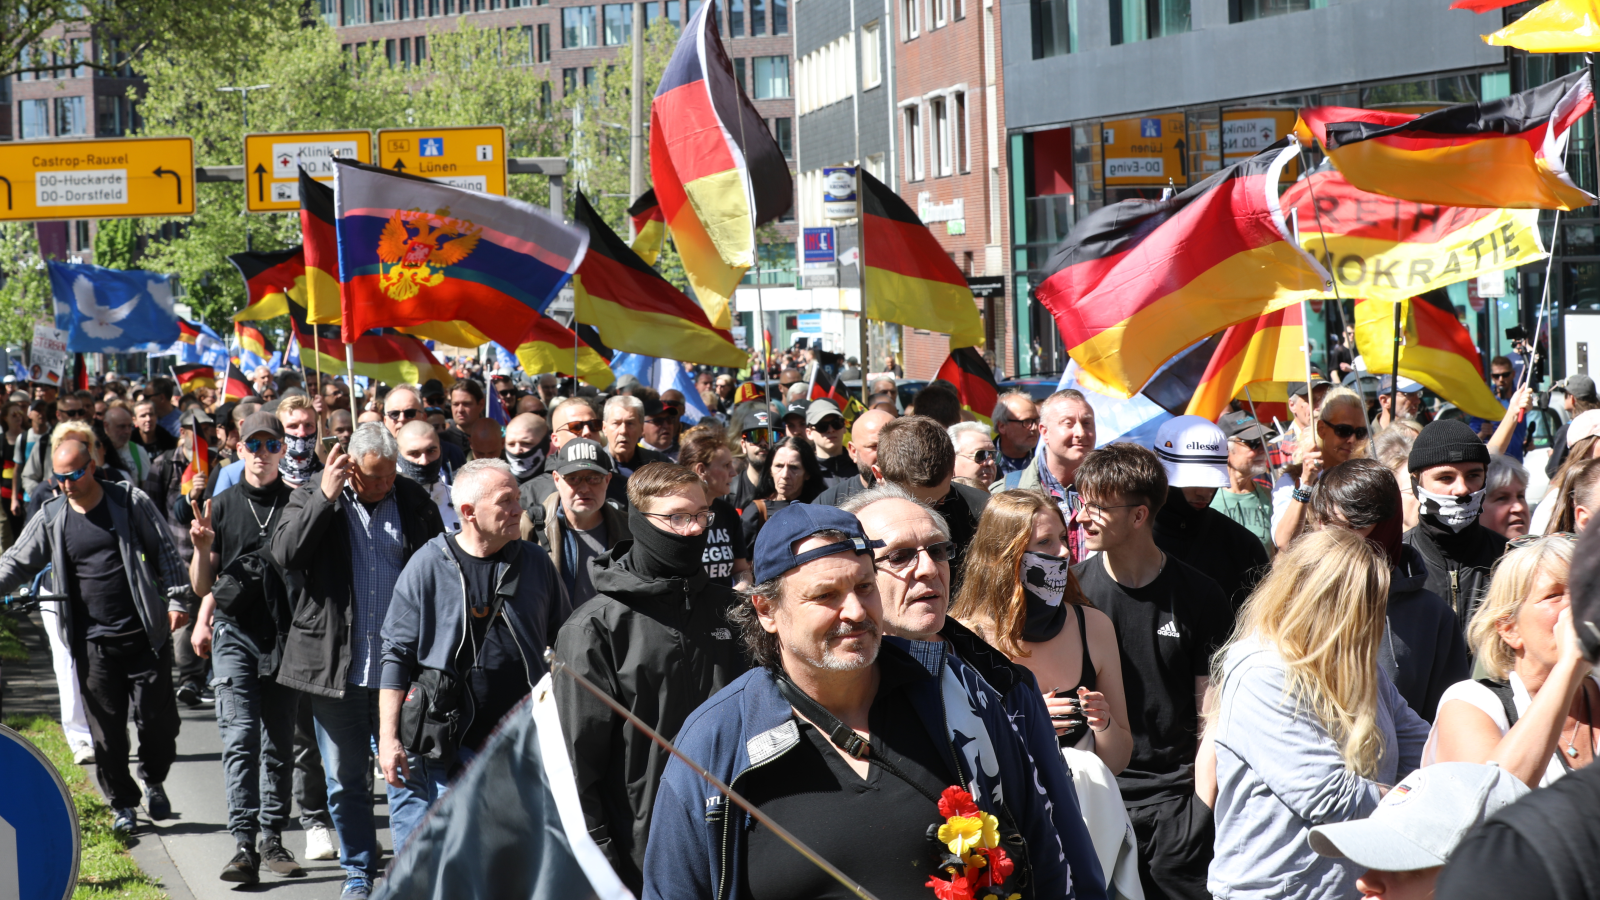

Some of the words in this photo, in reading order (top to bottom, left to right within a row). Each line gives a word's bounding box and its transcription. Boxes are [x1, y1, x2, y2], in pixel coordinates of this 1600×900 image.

[299, 146, 353, 157] Klinikm
[393, 142, 404, 150] 54
[32, 153, 128, 168] Castrop-Rauxel
[419, 162, 456, 173] Lünen
[40, 174, 122, 187] DO-Huckarde
[41, 188, 122, 202] DO-Dorstfeld
[1504, 276, 1516, 295] 19
[567, 442, 597, 462] KING
[1186, 441, 1219, 451] ellesse
[1157, 629, 1180, 638] adidas
